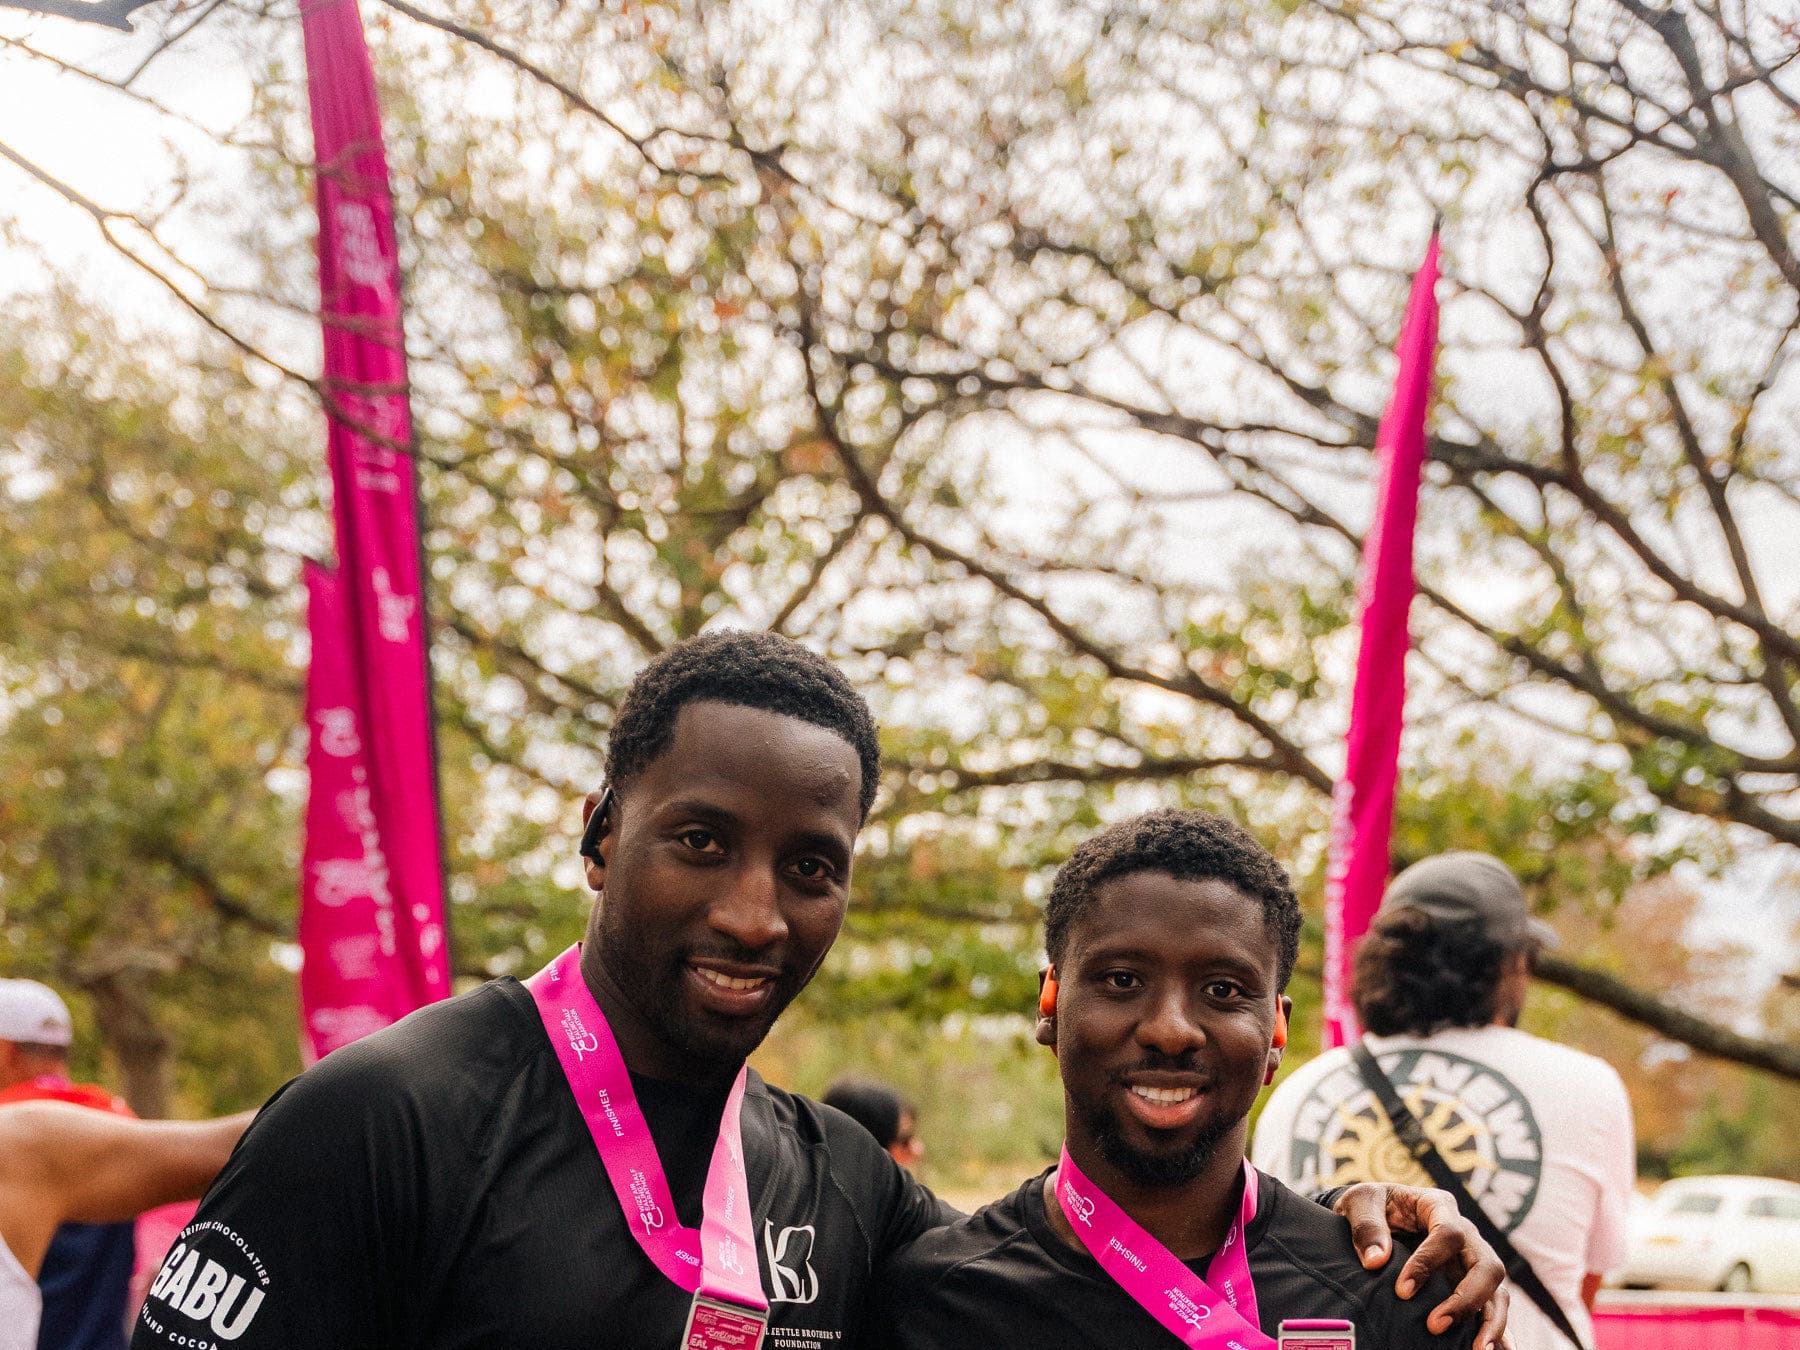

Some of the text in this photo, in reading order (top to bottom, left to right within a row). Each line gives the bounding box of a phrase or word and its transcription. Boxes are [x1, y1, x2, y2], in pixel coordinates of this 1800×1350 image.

[598, 1088, 624, 1137] FINISHER
[180, 1221, 271, 1286] BRITISH CHOCOLATIER
[1110, 1236, 1147, 1272] FINISHER
[150, 1242, 266, 1341] GABU
[771, 1328, 800, 1337] KETTLE
[802, 1328, 833, 1339] BROTHERS
[835, 1331, 841, 1339] U
[774, 1339, 821, 1350] FOUNDATION
